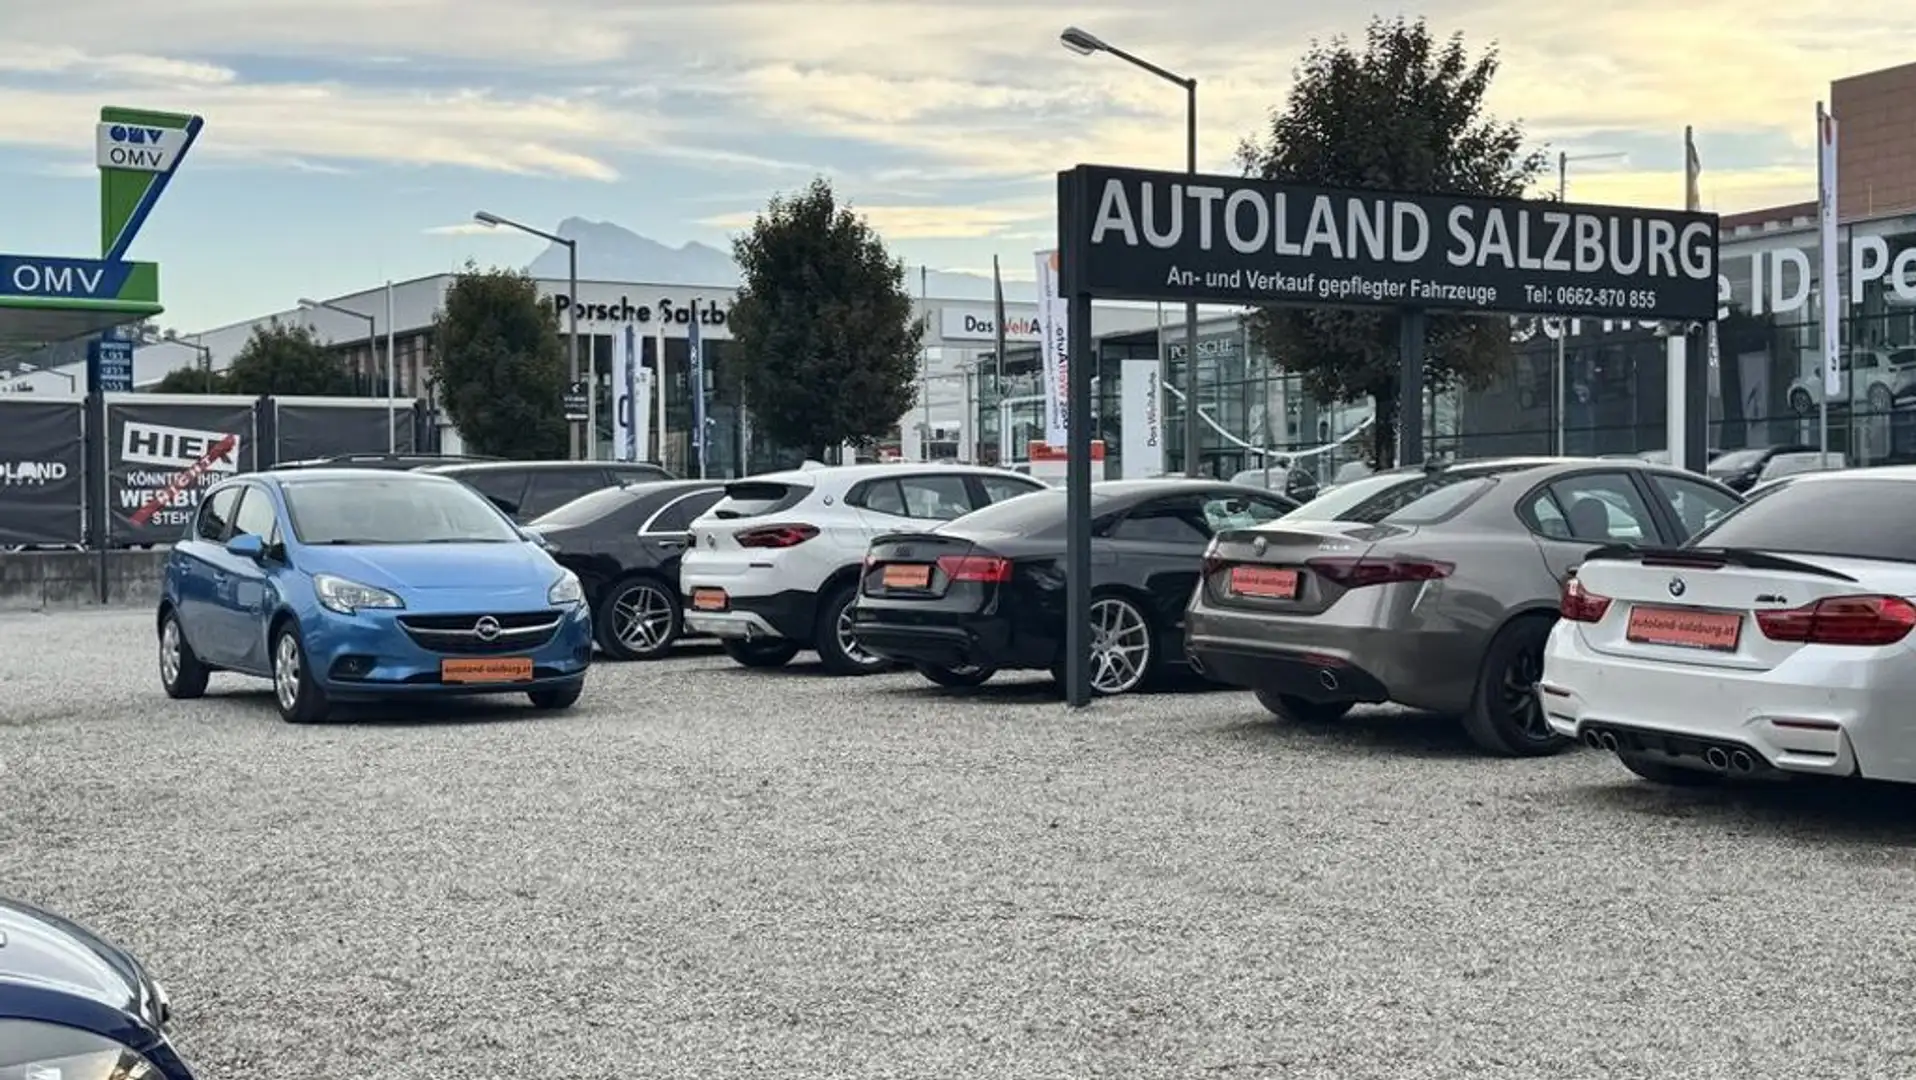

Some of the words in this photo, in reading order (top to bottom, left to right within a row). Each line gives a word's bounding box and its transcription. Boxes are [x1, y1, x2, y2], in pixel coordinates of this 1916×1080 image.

[110, 148, 163, 167] OMV
[1091, 178, 1430, 262] AUTOLAND
[1447, 204, 1713, 280] SALZBURG
[13, 264, 104, 294] OMV
[1166, 265, 1201, 286] An-
[1206, 269, 1241, 288] und
[1246, 269, 1316, 293] Verkauf
[1319, 275, 1406, 300] gepflegter
[1410, 279, 1498, 305] Fahrzeuge
[1524, 284, 1553, 305] Tel:
[1556, 286, 1626, 308] 0662-870
[1629, 289, 1657, 309] 855
[657, 298, 726, 325] Salzb
[965, 315, 994, 333] Das
